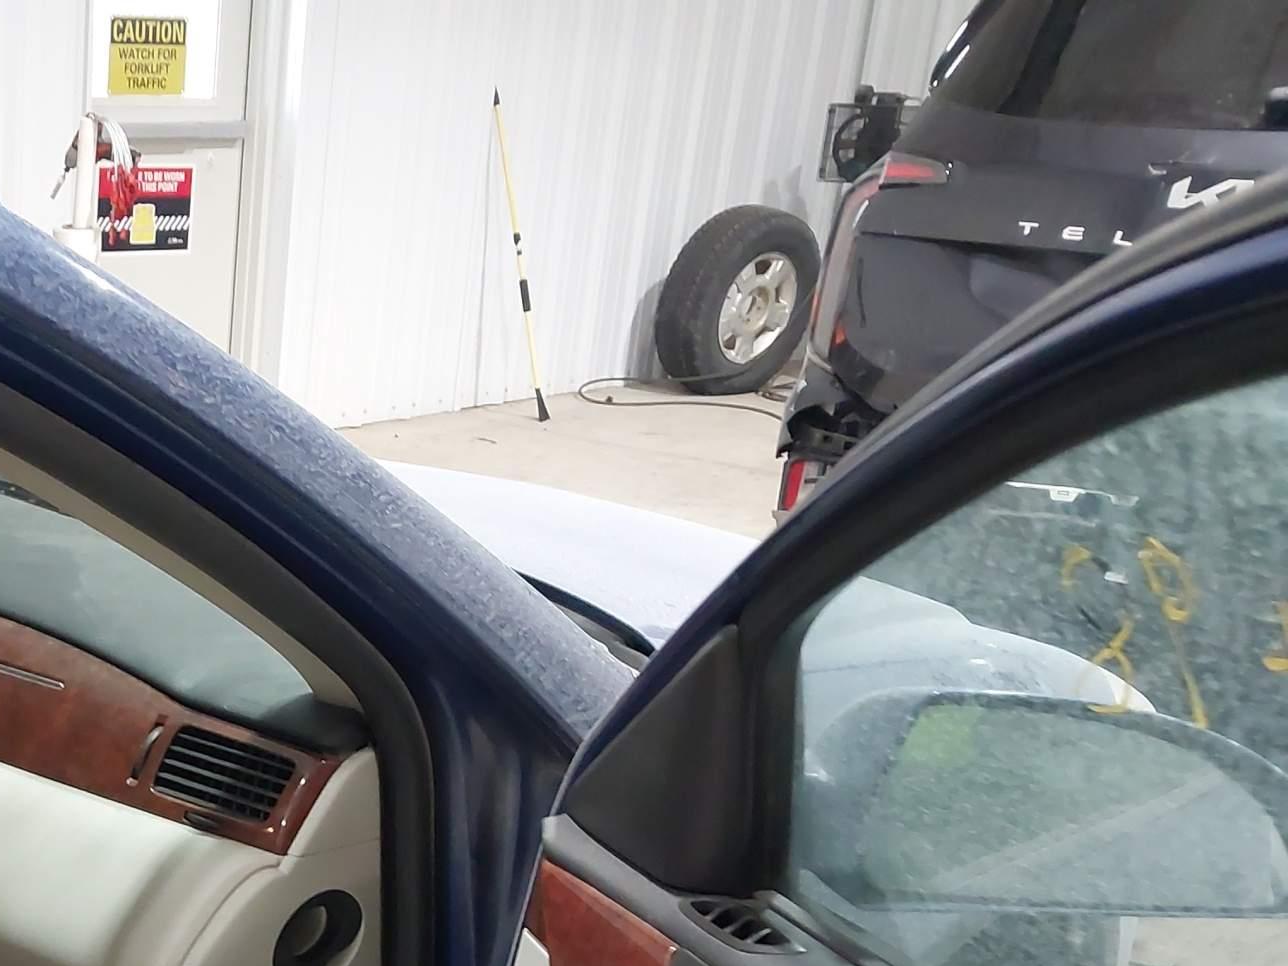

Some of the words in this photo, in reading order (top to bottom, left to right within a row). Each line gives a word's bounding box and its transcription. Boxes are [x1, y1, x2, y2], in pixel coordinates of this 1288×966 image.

[112, 18, 184, 43] CAUTION
[118, 47, 155, 60] WATCH
[157, 48, 177, 61] FOR
[124, 62, 170, 75] FORKLIFT
[126, 77, 167, 89] TRAFFIC
[144, 171, 153, 181] TO
